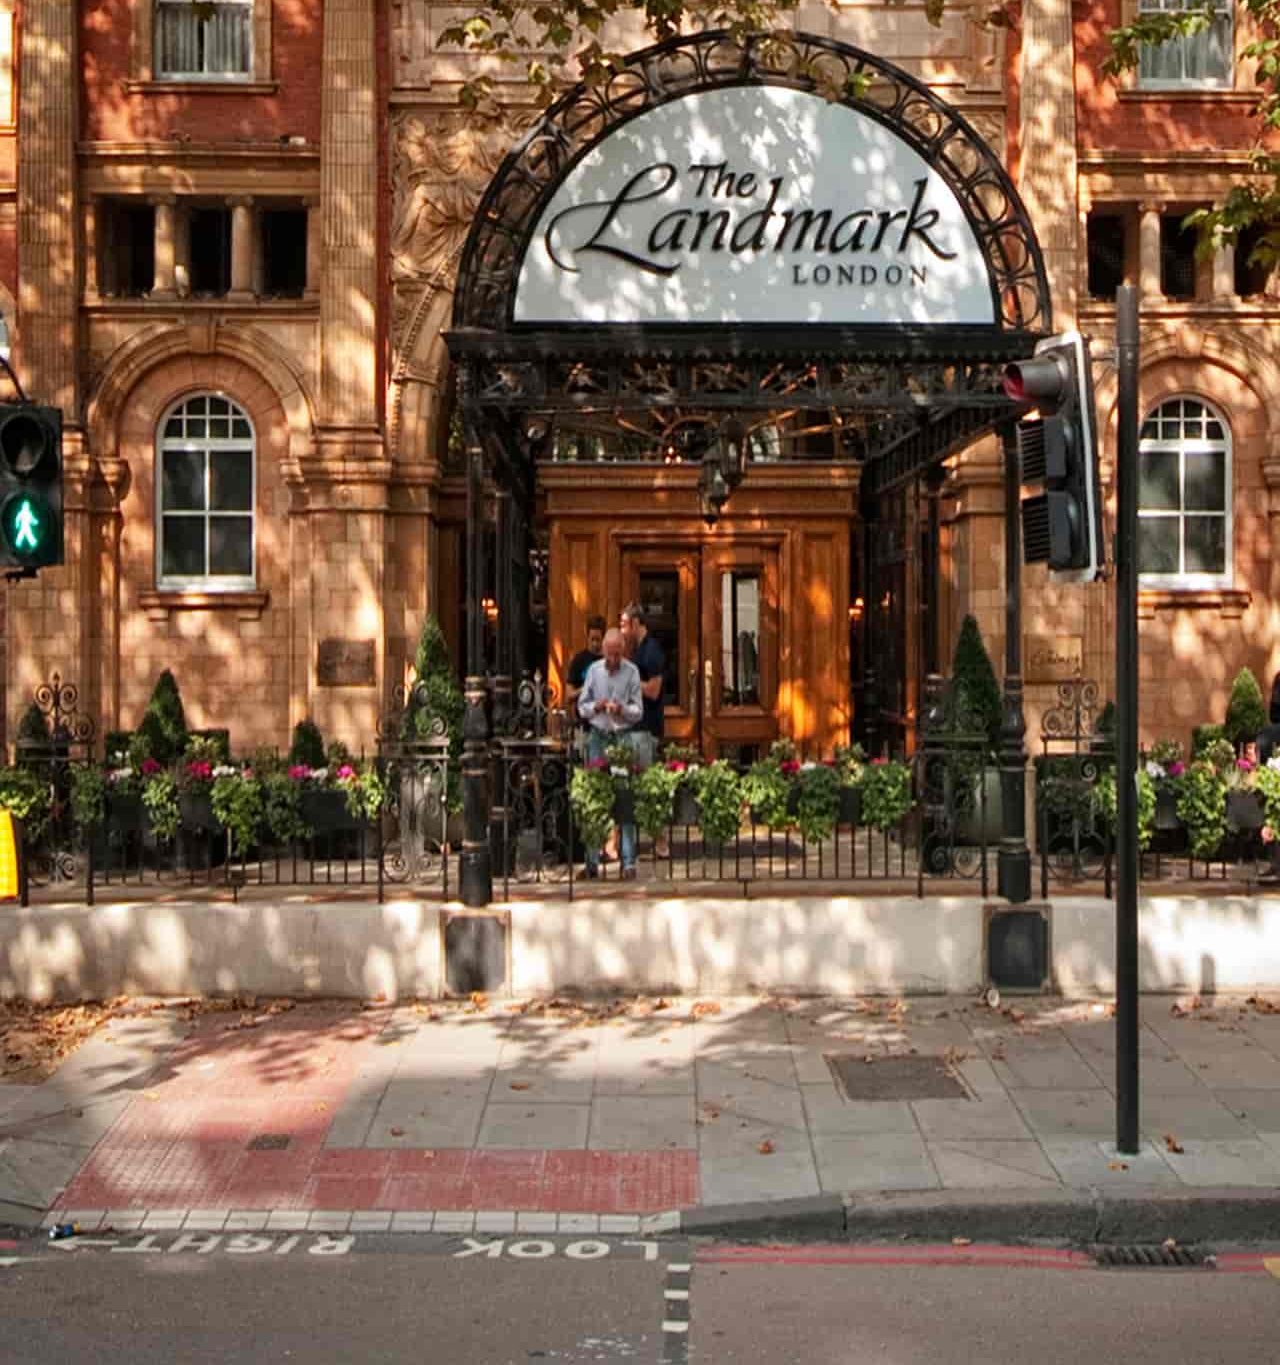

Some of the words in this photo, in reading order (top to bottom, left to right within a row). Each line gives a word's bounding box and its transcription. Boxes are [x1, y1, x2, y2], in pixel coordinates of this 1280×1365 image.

[688, 161, 759, 198] The
[545, 163, 958, 277] Landmark
[793, 264, 930, 287] LONDON
[110, 1233, 357, 1254] RIGHT
[452, 1238, 659, 1261] LOOK
